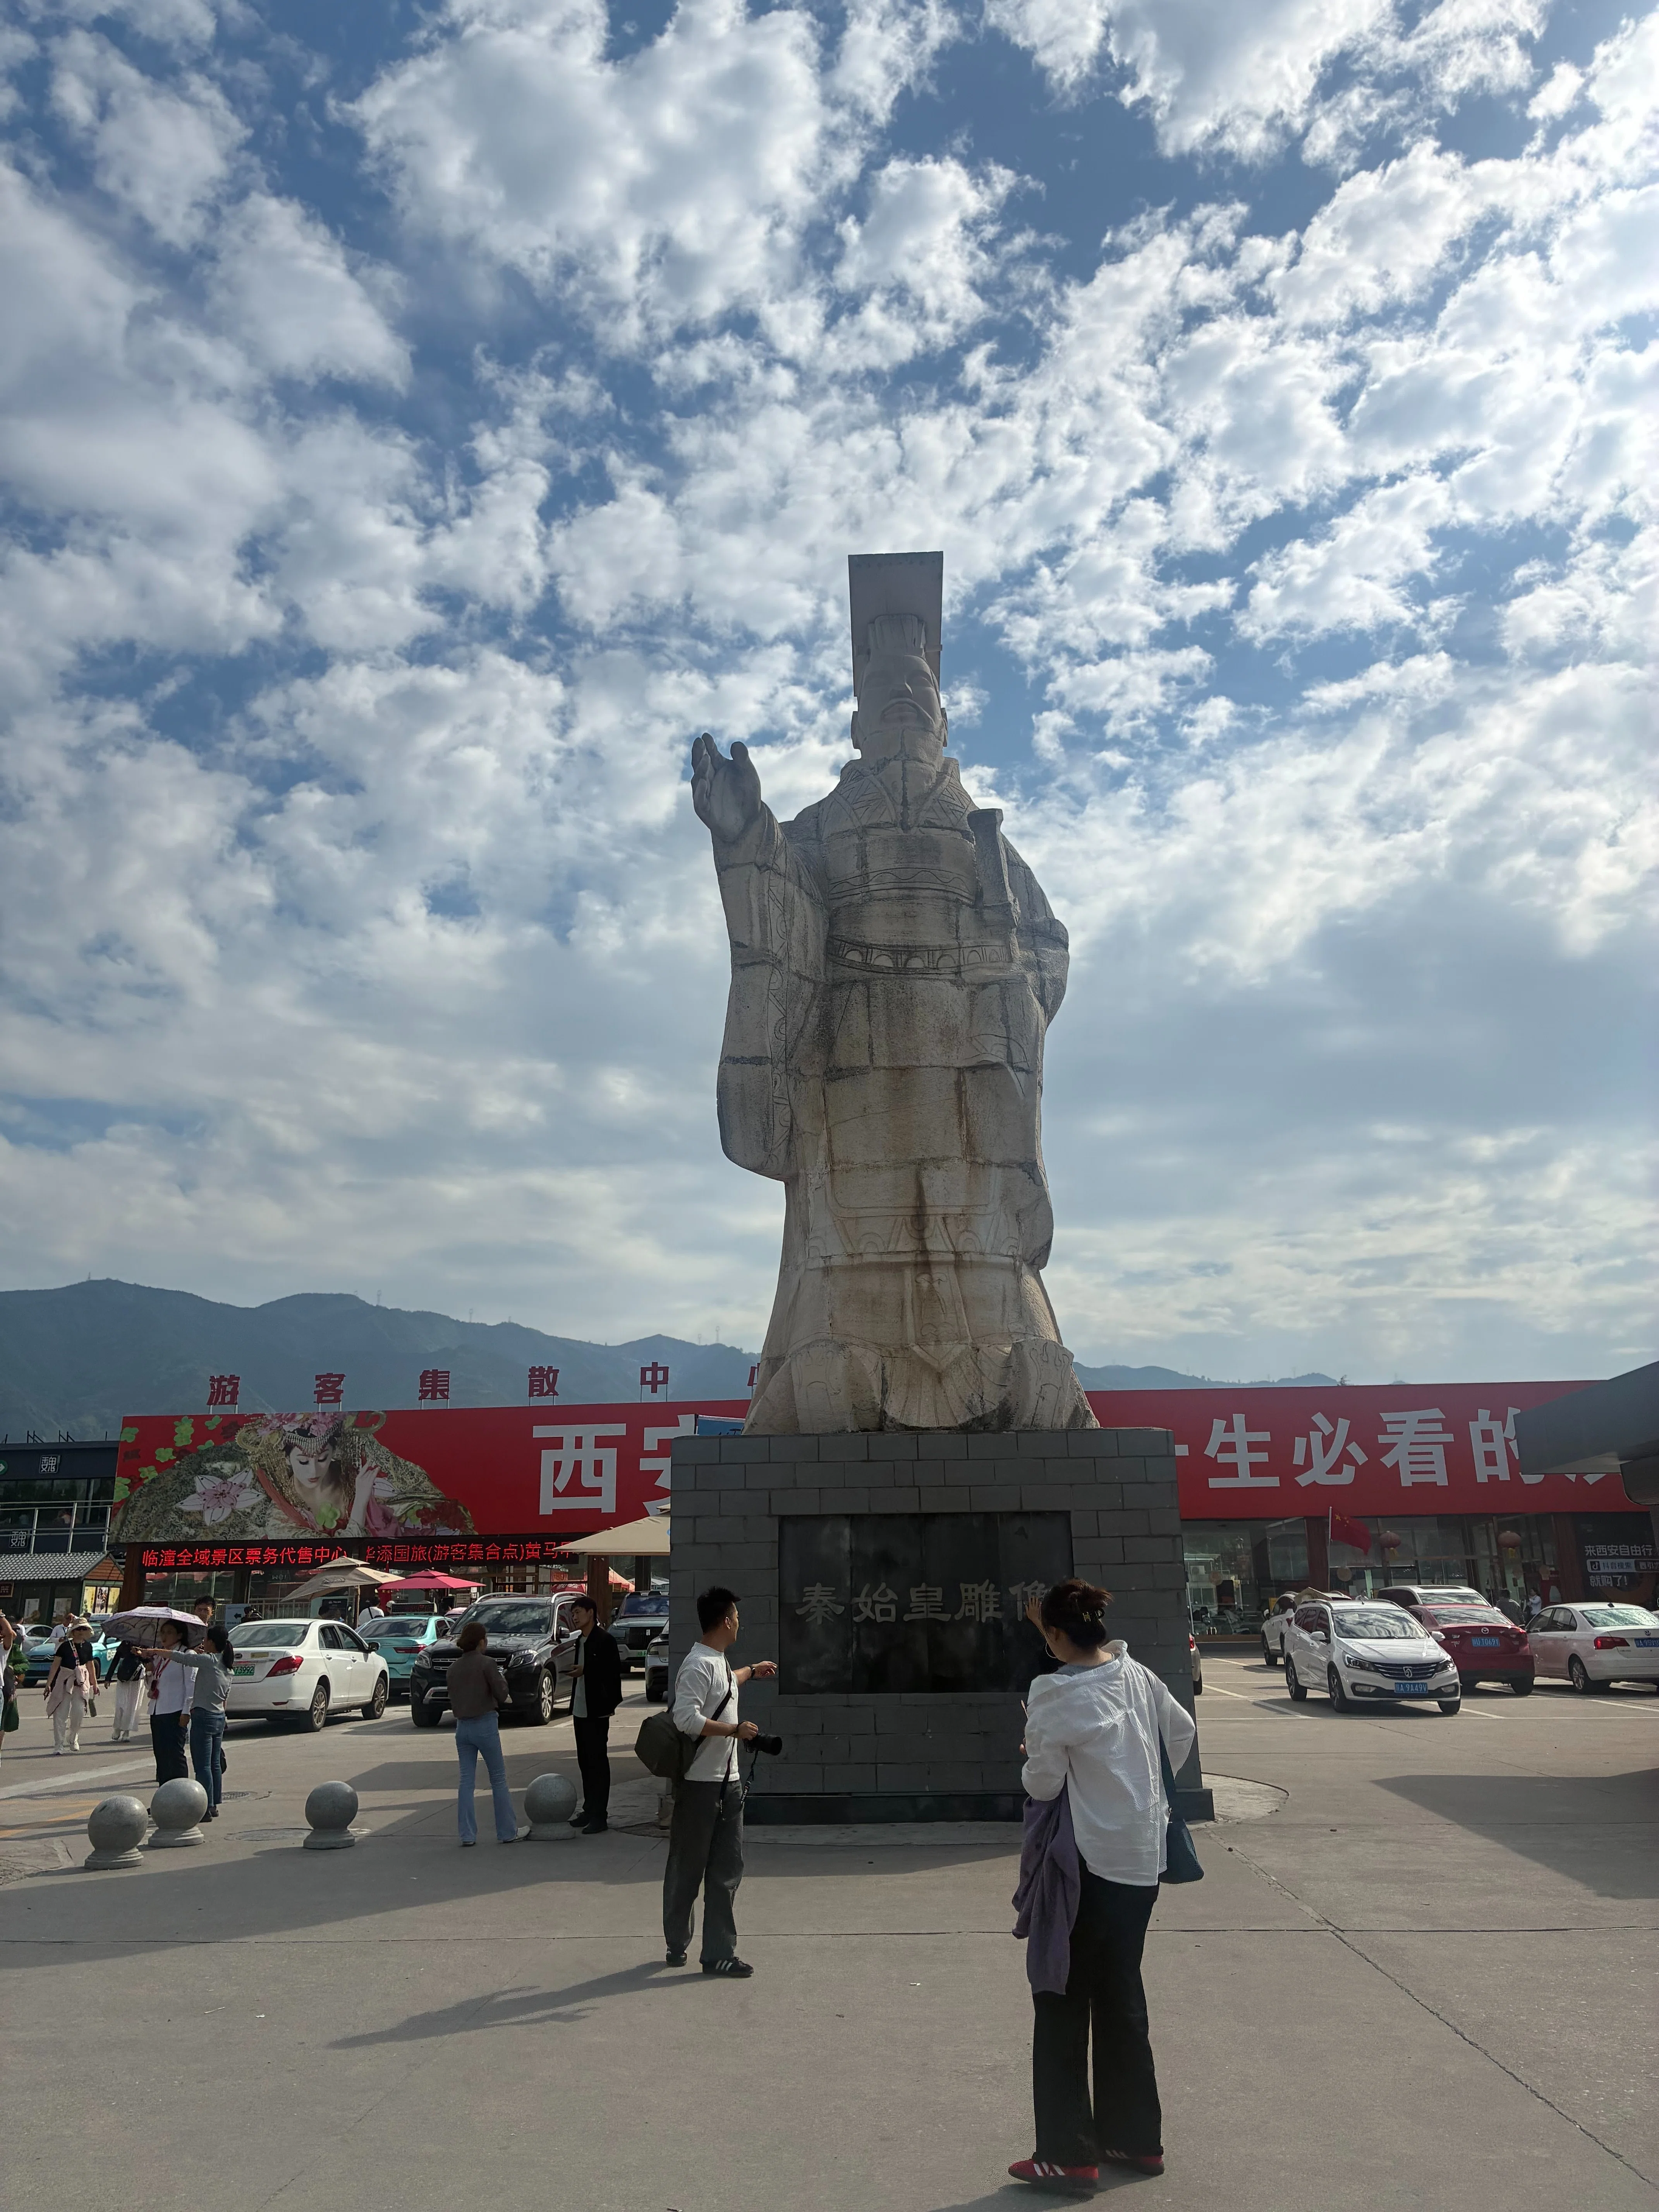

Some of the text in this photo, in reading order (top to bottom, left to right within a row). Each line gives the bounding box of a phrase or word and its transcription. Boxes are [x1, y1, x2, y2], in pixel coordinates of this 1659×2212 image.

[1175, 1407, 1607, 1488] 生必看的
[41, 1456, 57, 1472] 魏
[11, 1530, 27, 1547] 魏
[143, 1546, 347, 1567] 临潼全域景区票务代售中心
[1585, 1544, 1652, 1556] 来西安自由行
[234, 1666, 254, 1674] 73992
